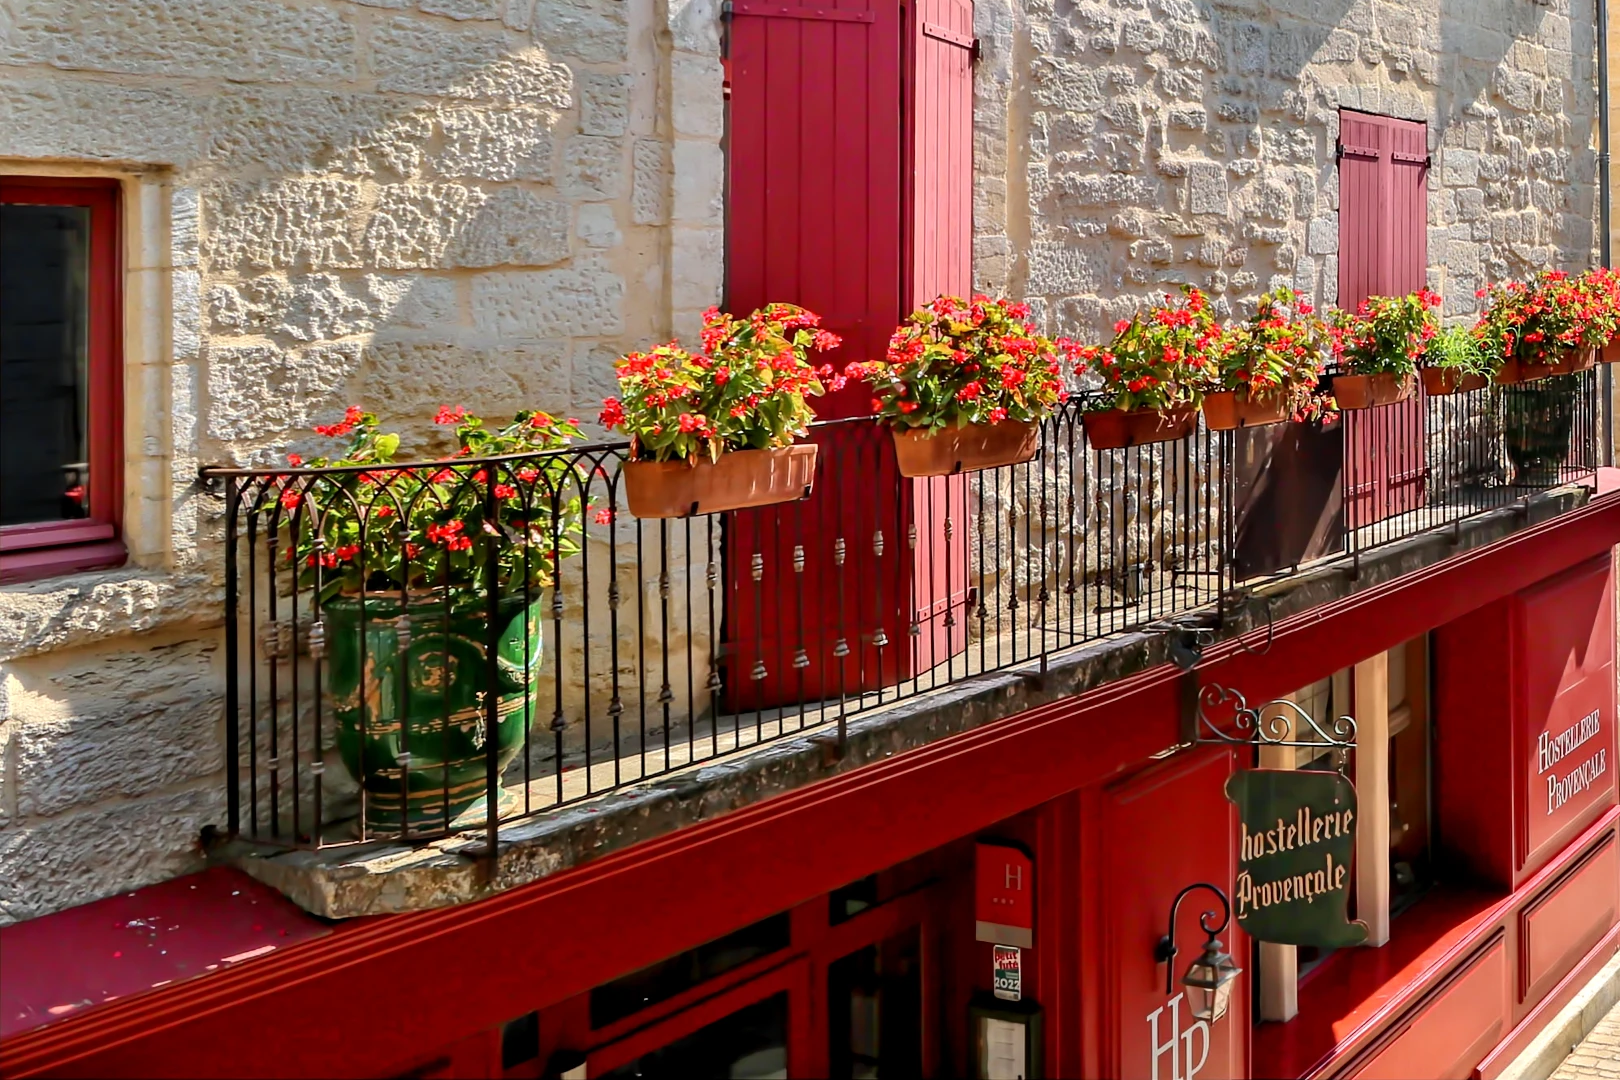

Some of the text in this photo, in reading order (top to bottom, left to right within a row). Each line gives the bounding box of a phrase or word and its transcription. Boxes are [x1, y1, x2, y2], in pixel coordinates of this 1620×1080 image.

[1241, 798, 1354, 862] hostellerie
[1005, 863, 1022, 890] H
[1236, 853, 1346, 919] Provençale
[994, 951, 1018, 963] petit
[995, 977, 1020, 990] 2022
